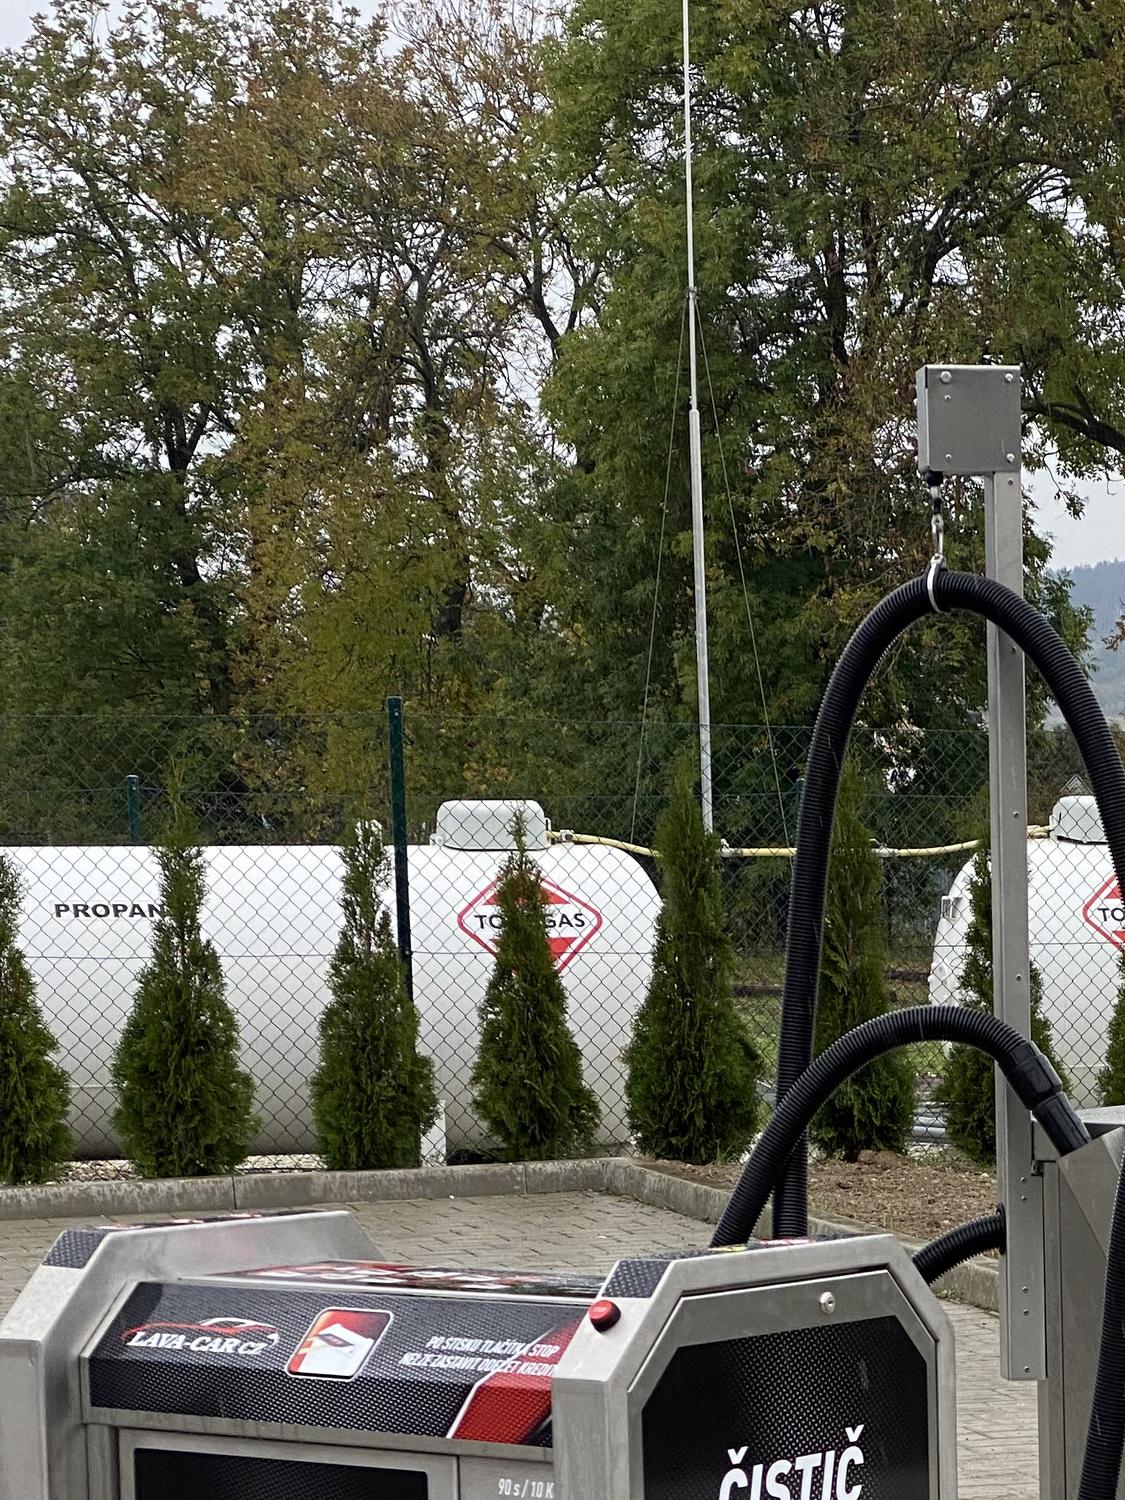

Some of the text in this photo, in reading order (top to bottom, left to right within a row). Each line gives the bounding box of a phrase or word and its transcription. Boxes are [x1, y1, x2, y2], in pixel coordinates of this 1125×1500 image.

[54, 903, 166, 918] PROPAN
[474, 912, 586, 930] TOGAS
[126, 1332, 270, 1355] LAVA-CAR CZ
[425, 1336, 442, 1349] PO
[528, 1343, 561, 1358] STOP
[498, 1478, 511, 1496] 90
[545, 1482, 555, 1499] K
